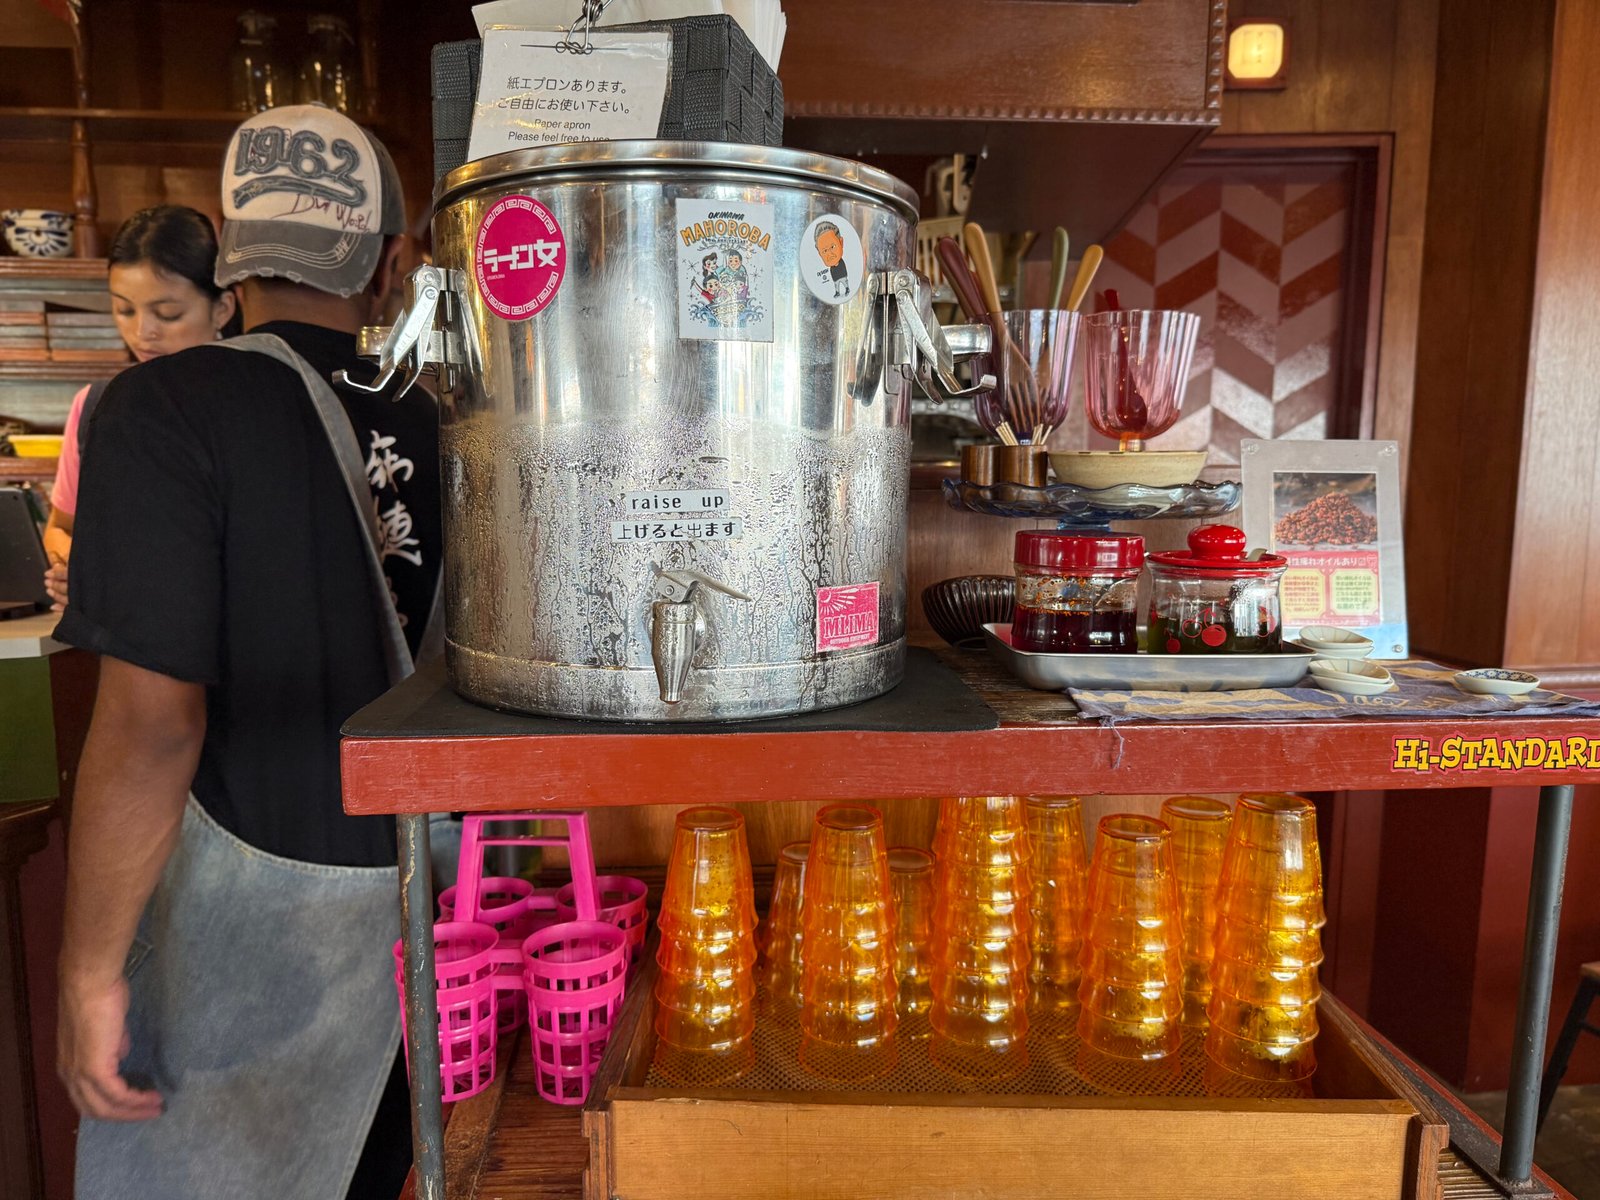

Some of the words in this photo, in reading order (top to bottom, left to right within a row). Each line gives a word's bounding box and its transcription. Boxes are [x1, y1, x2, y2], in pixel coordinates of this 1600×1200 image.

[507, 76, 627, 94] 紙エプロンあります。
[497, 97, 630, 114] ご自由にお使い下さい。
[534, 118, 562, 130] Paper
[563, 120, 591, 132] apron
[508, 131, 540, 142] Please
[541, 132, 559, 143] feel
[560, 133, 579, 144] free
[234, 125, 366, 184] 1962
[708, 211, 745, 221] OKINAWA
[680, 219, 771, 251] MAHOROBA
[632, 495, 682, 510] raise
[702, 495, 724, 509] up
[617, 521, 736, 540] 上げると出ます
